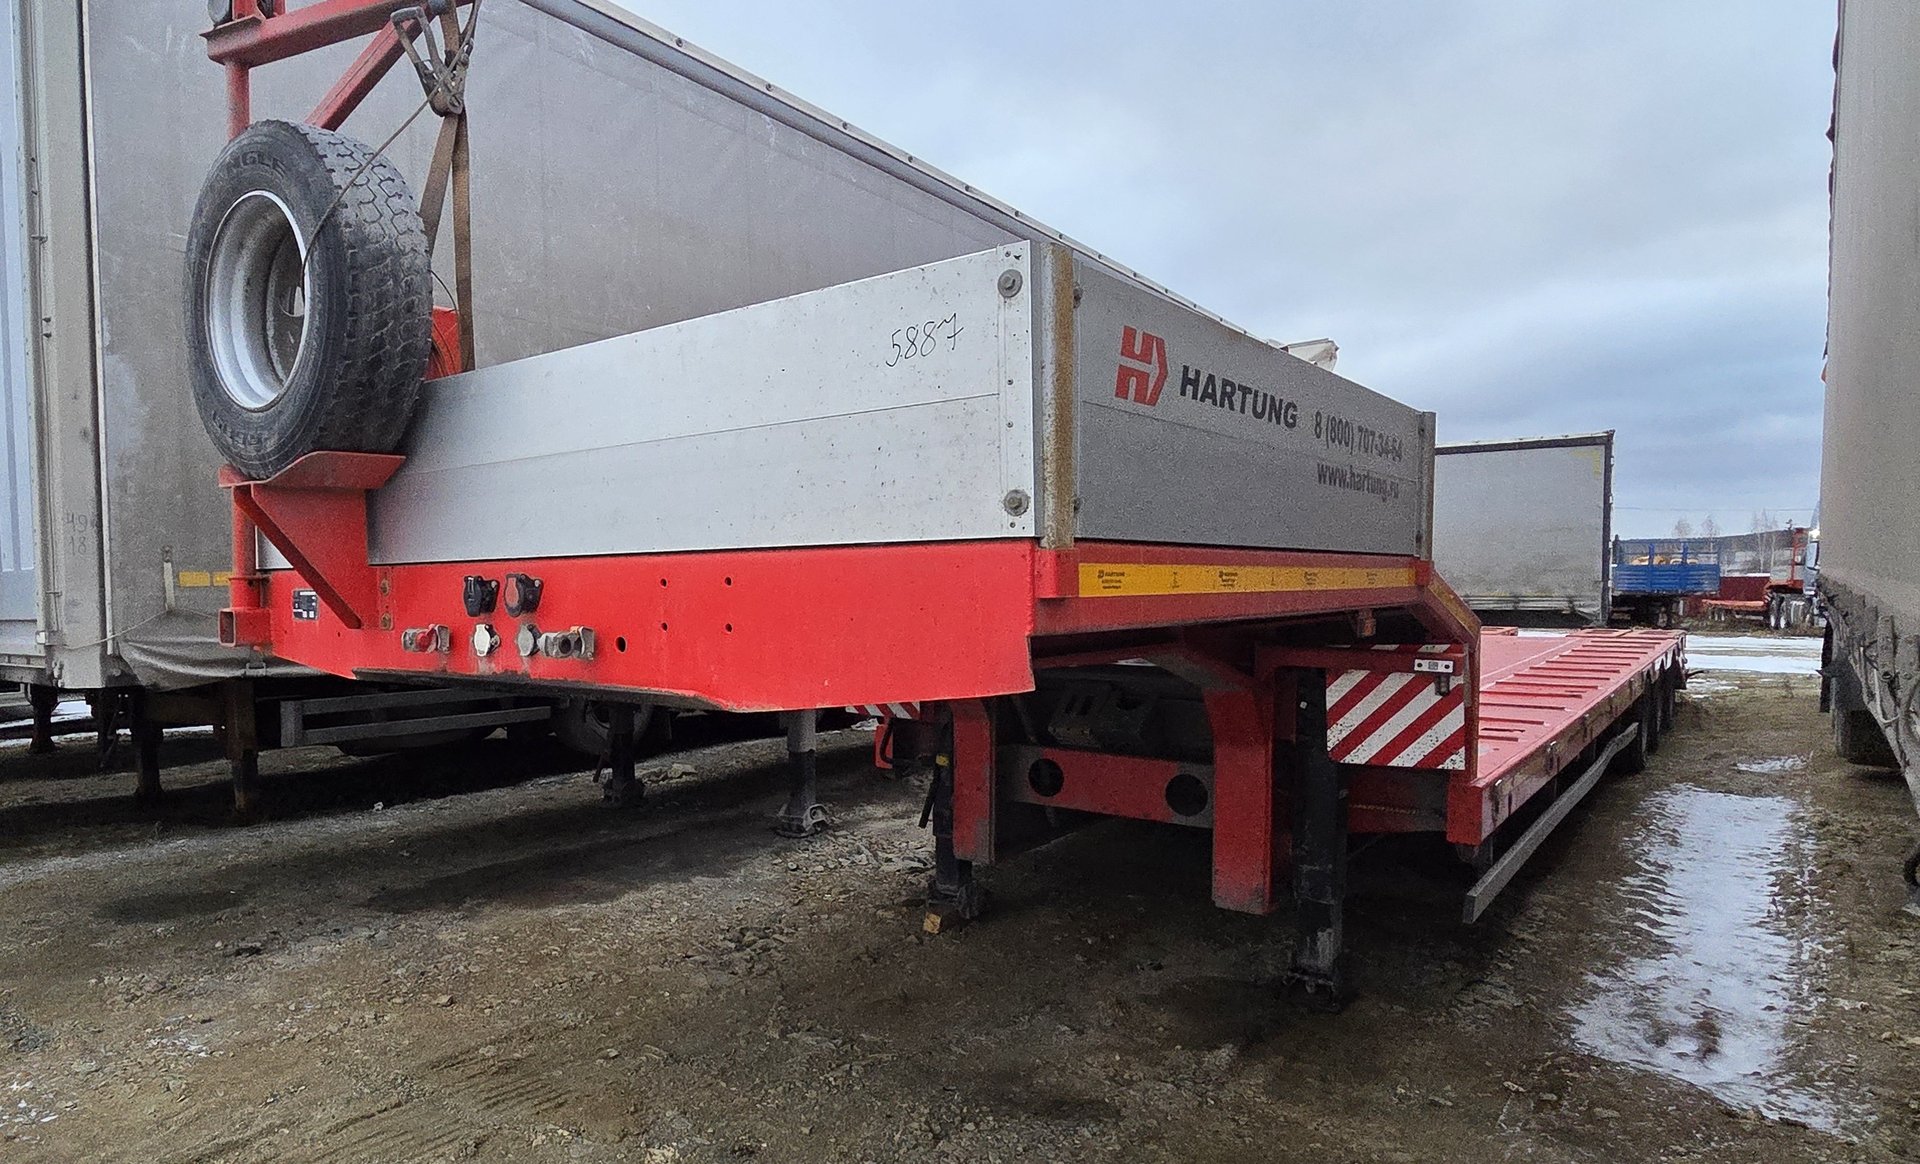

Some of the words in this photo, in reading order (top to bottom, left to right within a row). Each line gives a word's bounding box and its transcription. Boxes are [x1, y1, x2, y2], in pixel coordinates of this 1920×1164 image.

[885, 312, 964, 368] 5887
[1179, 364, 1299, 429] HARTUNG
[1314, 410, 1323, 439] 8
[1325, 414, 1355, 456] (800)
[1316, 461, 1400, 502] www.hartung.ru
